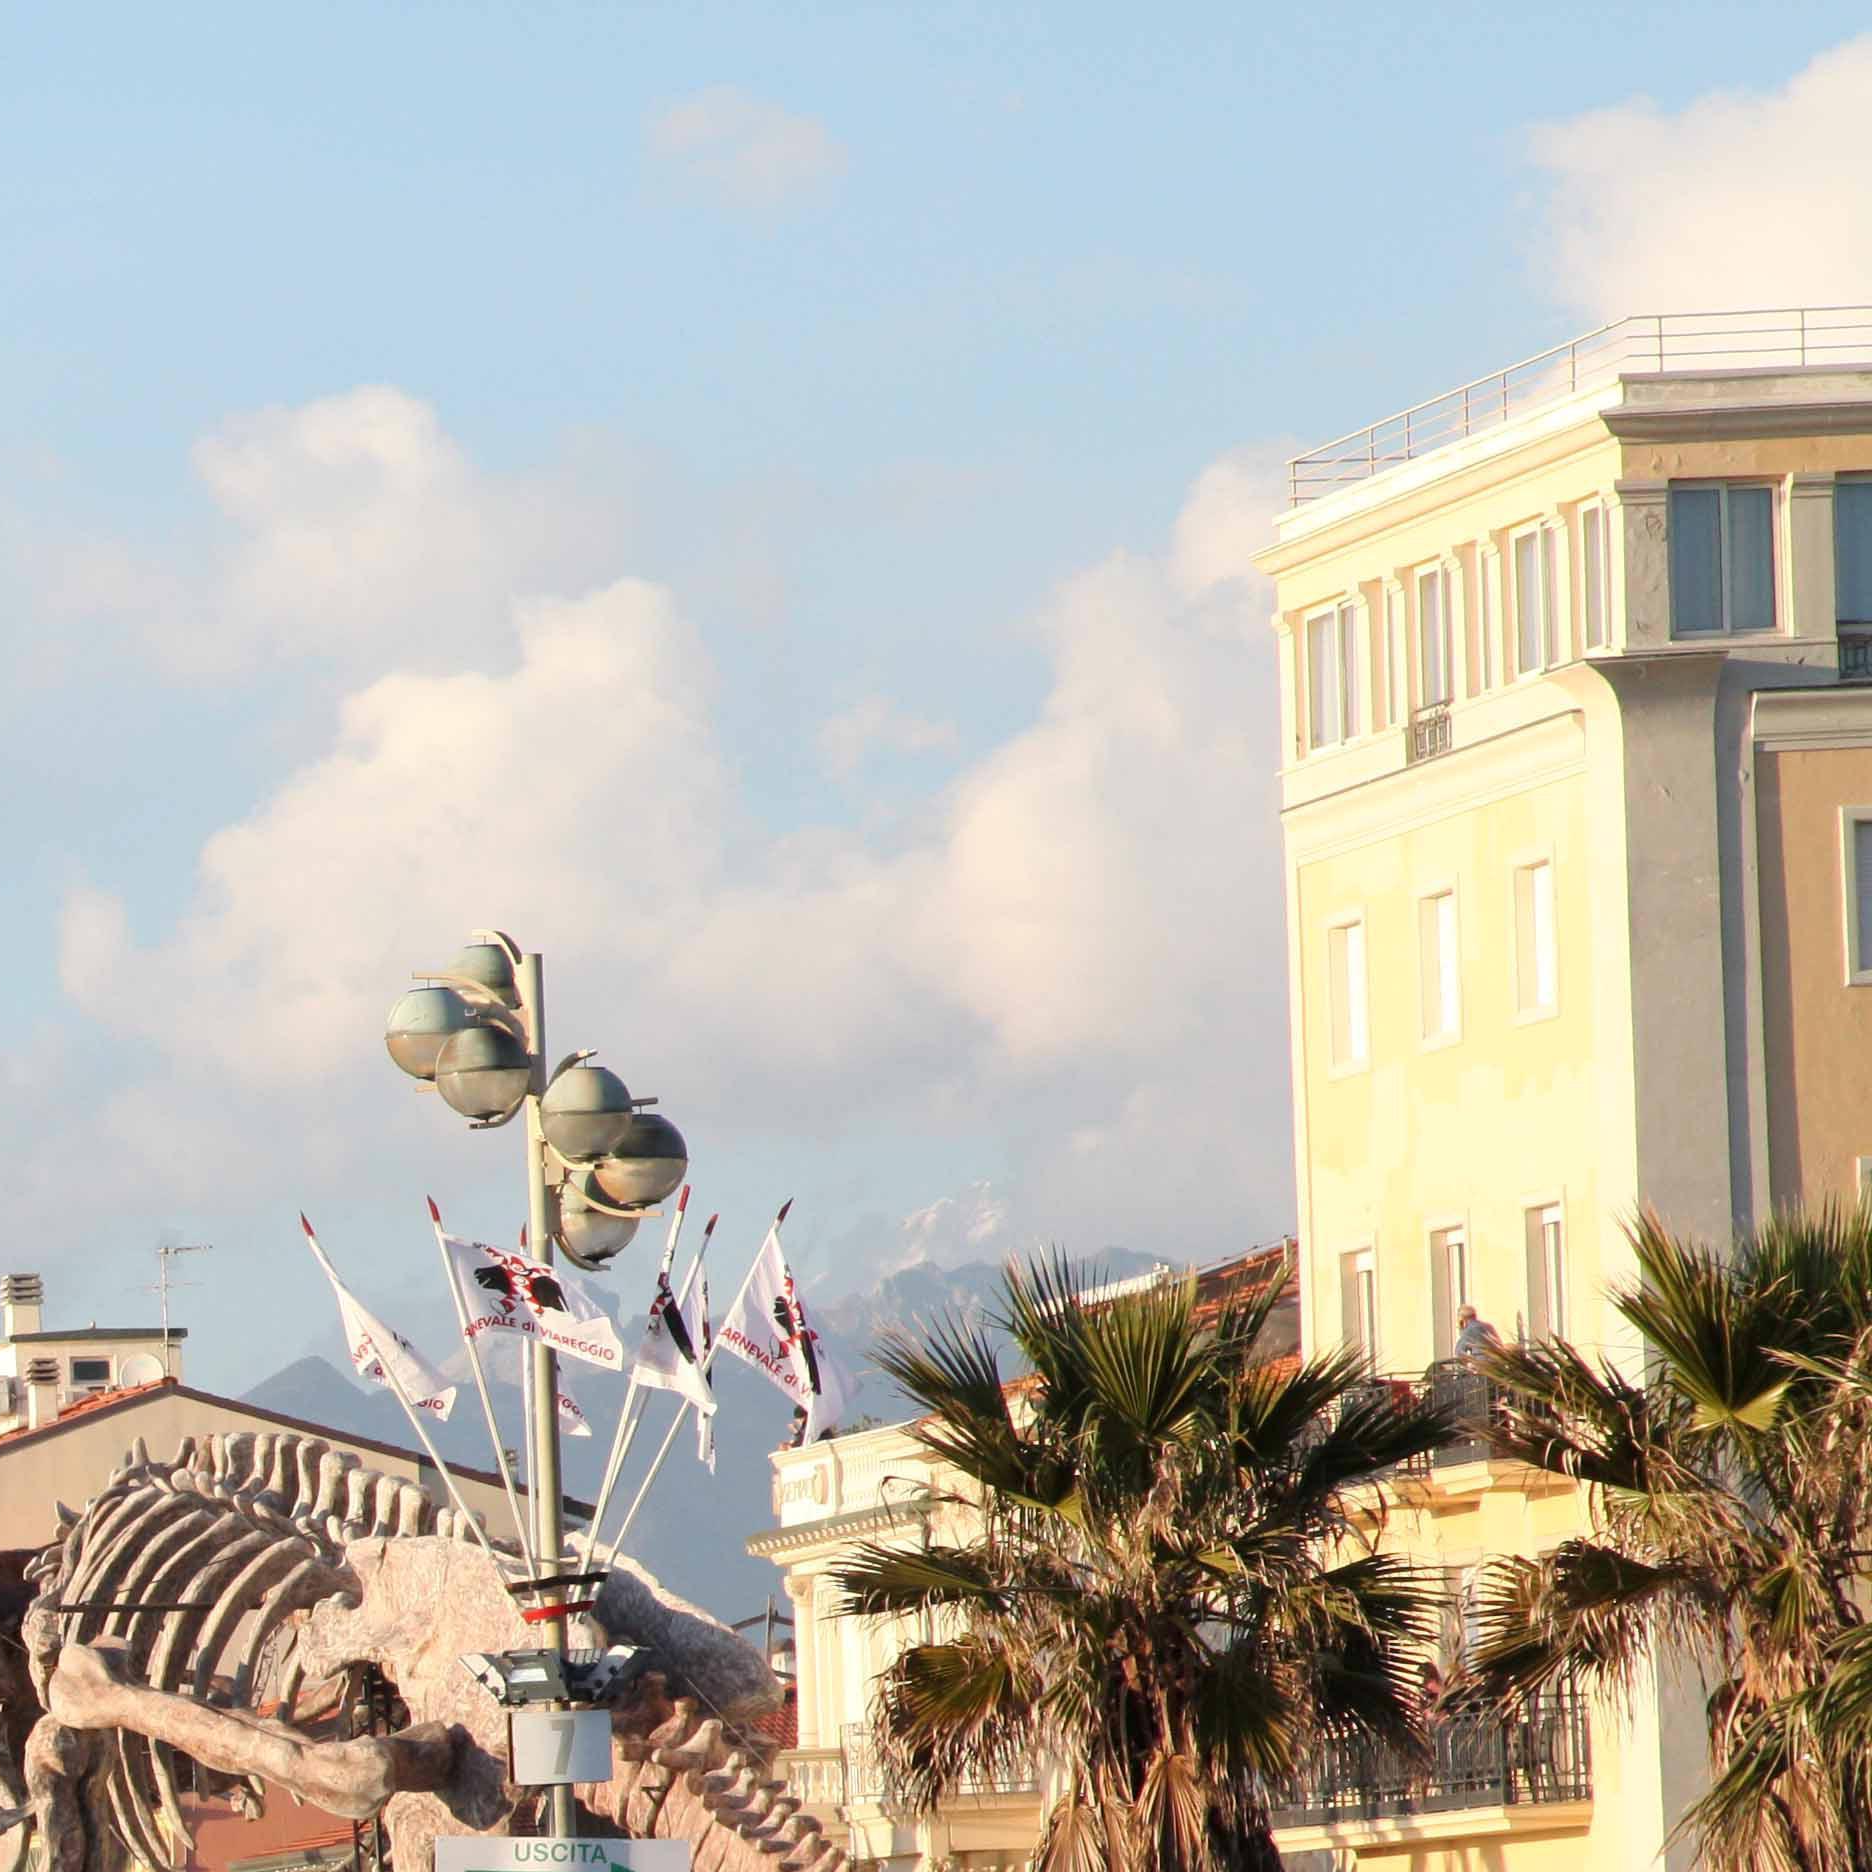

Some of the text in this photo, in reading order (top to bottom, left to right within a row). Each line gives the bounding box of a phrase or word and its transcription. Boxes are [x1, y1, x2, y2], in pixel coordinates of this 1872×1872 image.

[521, 1319, 535, 1334] di
[539, 1325, 615, 1361] VIAREGGIO
[720, 1326, 784, 1377] ARNEVALE
[548, 1718, 577, 1777] 7
[513, 1842, 607, 1865] USCITA
